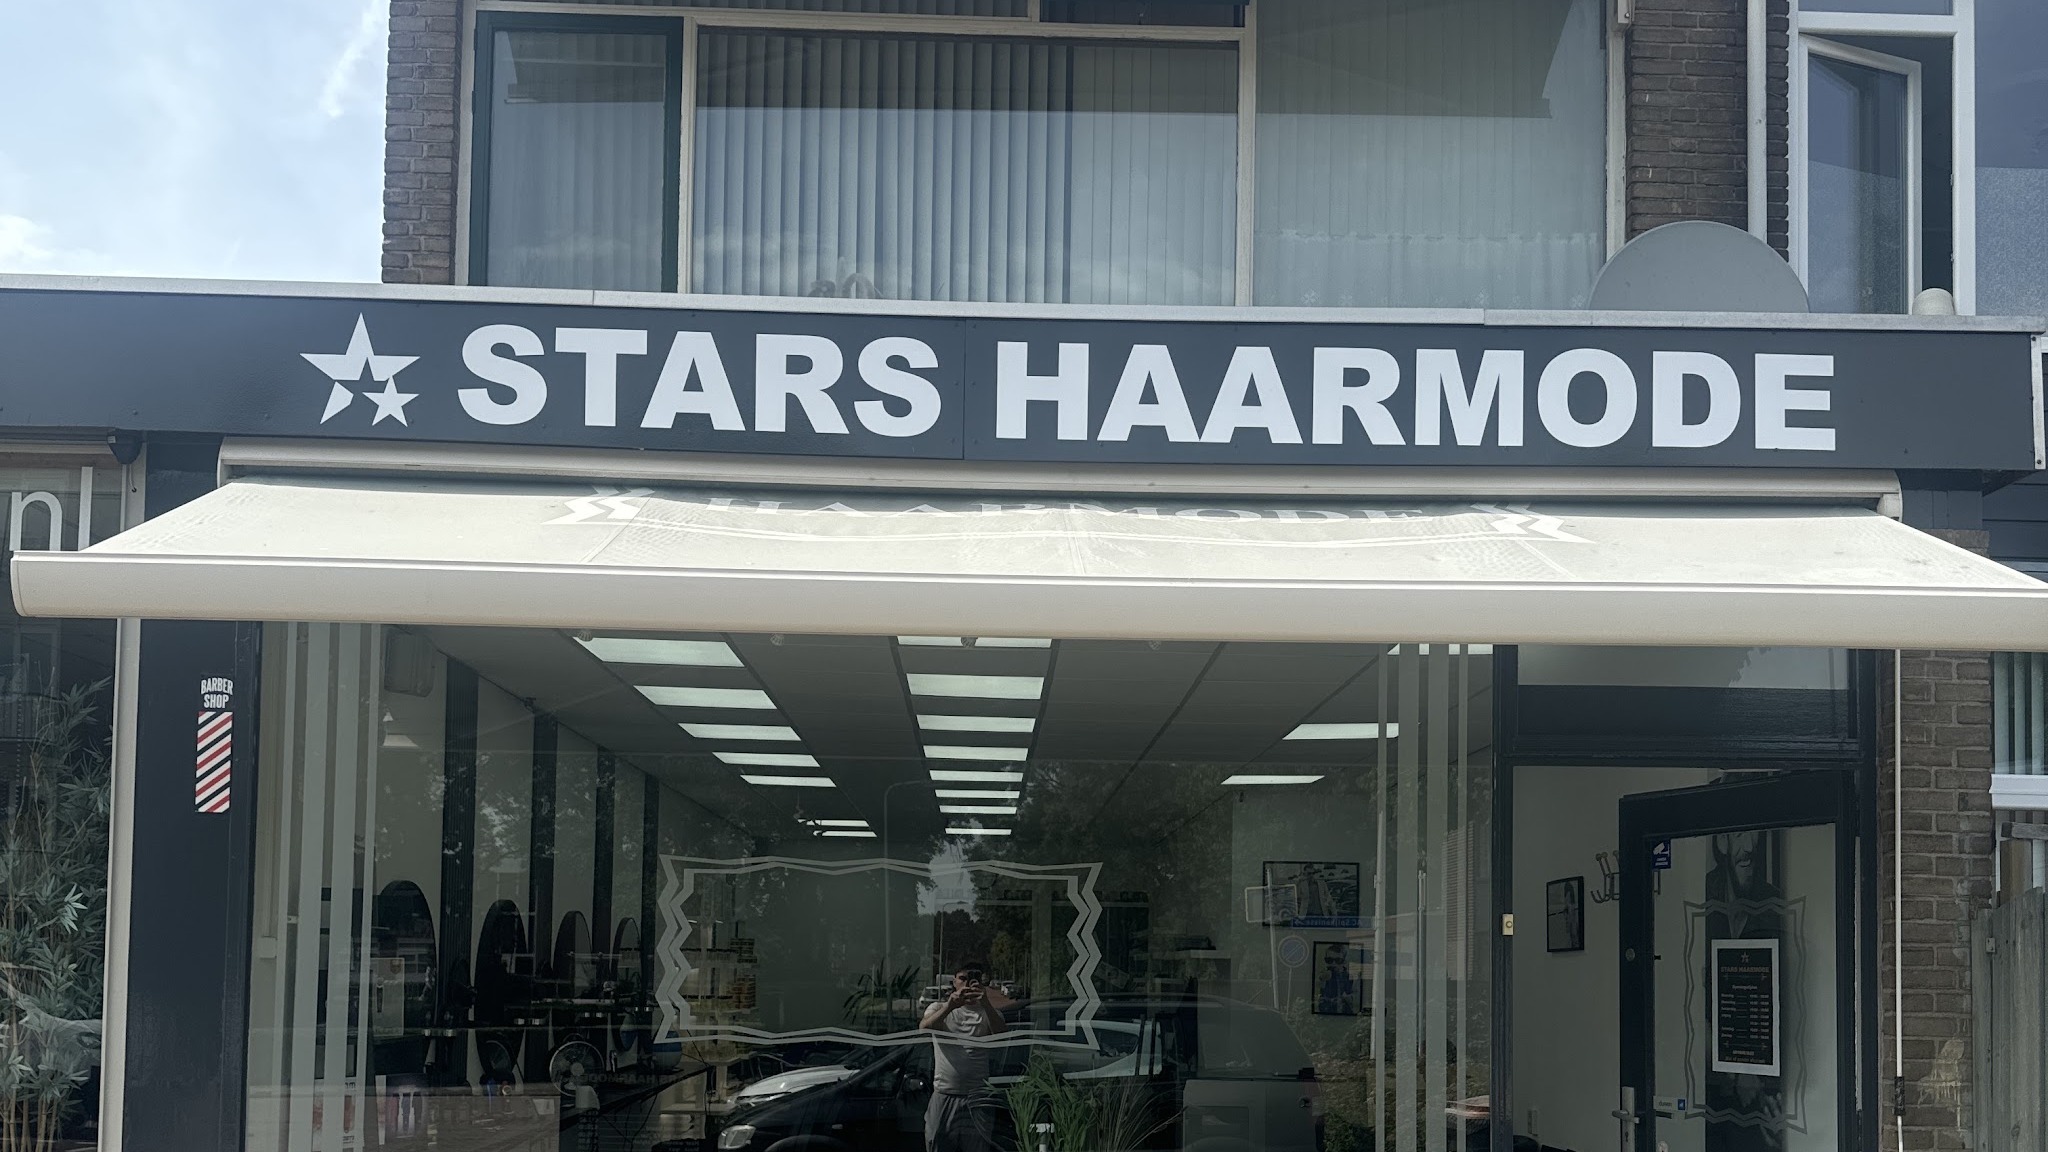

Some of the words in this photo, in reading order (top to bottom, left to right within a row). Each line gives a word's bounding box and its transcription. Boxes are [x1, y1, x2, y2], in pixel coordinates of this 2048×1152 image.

[457, 324, 942, 437] STARS
[996, 340, 1836, 451] HAARMODE
[201, 677, 234, 695] BARBER
[203, 693, 230, 709] SHOP
